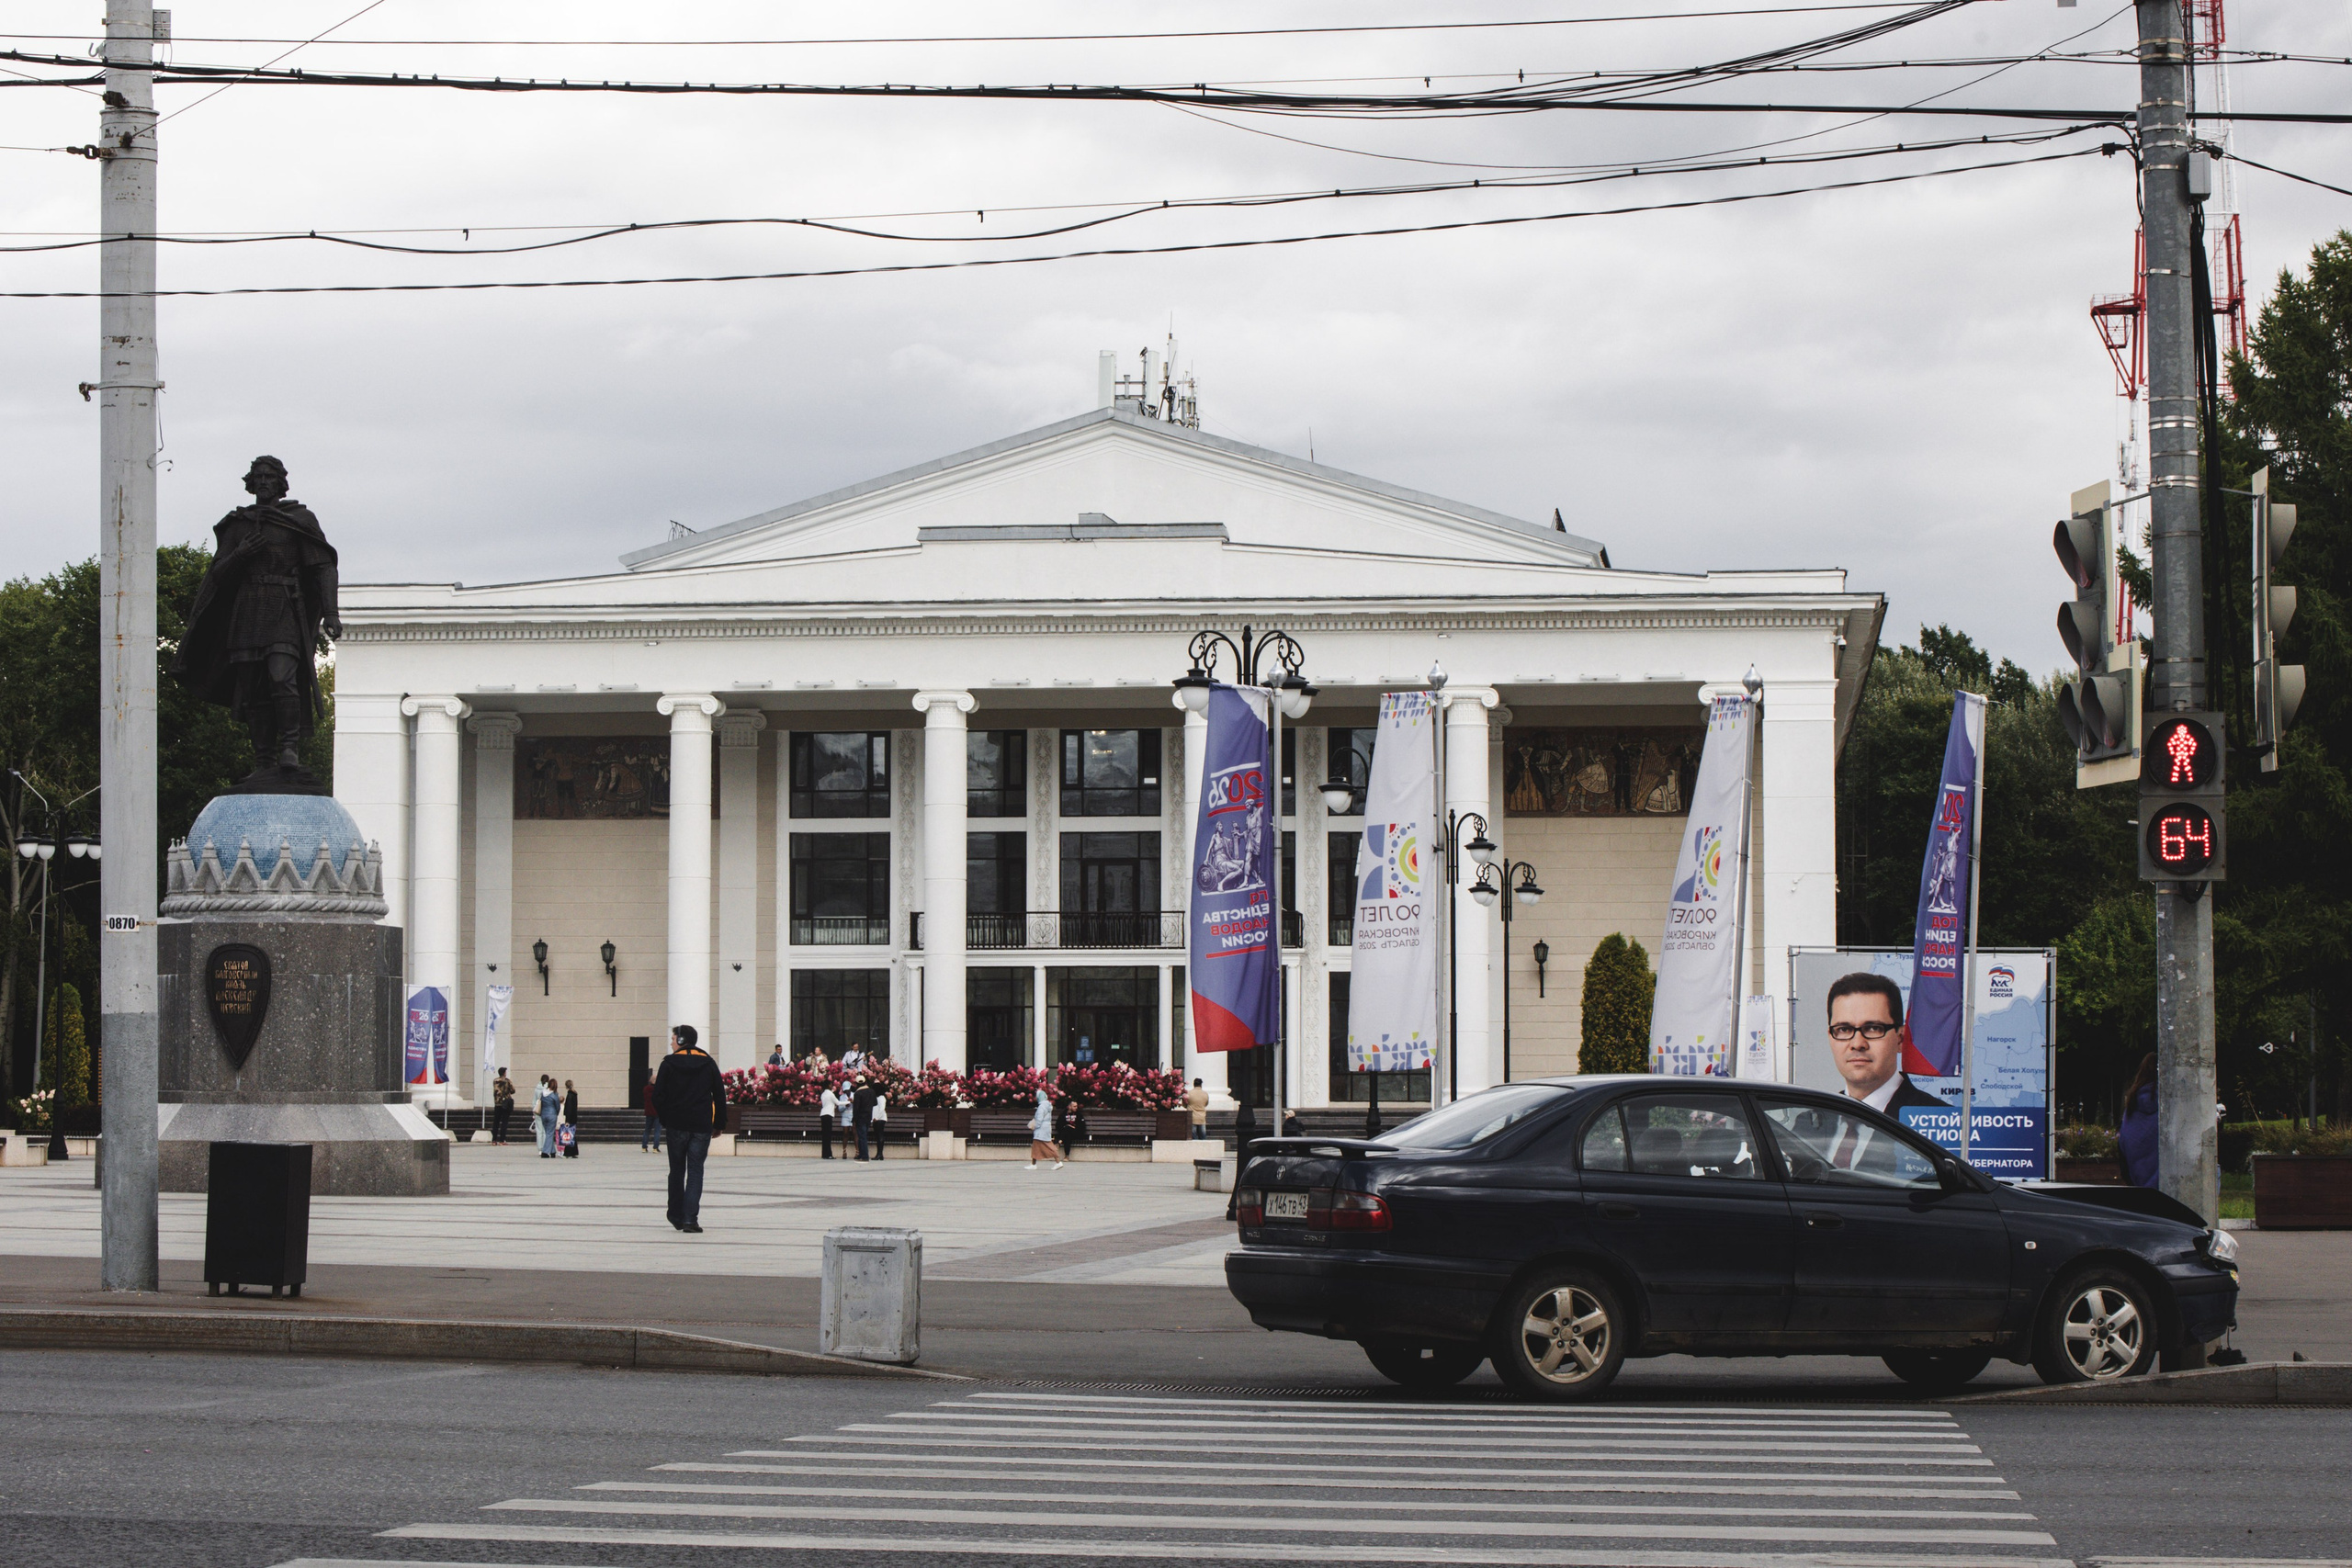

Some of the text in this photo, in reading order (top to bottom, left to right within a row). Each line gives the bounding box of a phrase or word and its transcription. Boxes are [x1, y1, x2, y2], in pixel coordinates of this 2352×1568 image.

[2161, 817, 2211, 861] 64
[108, 917, 136, 930] 0870
[1908, 1111, 2034, 1128] УСТОЙИВОСТЬ
[1913, 1129, 1981, 1142] ЕГИОА
[1968, 1159, 2033, 1168] УБЕРНАТОРА
